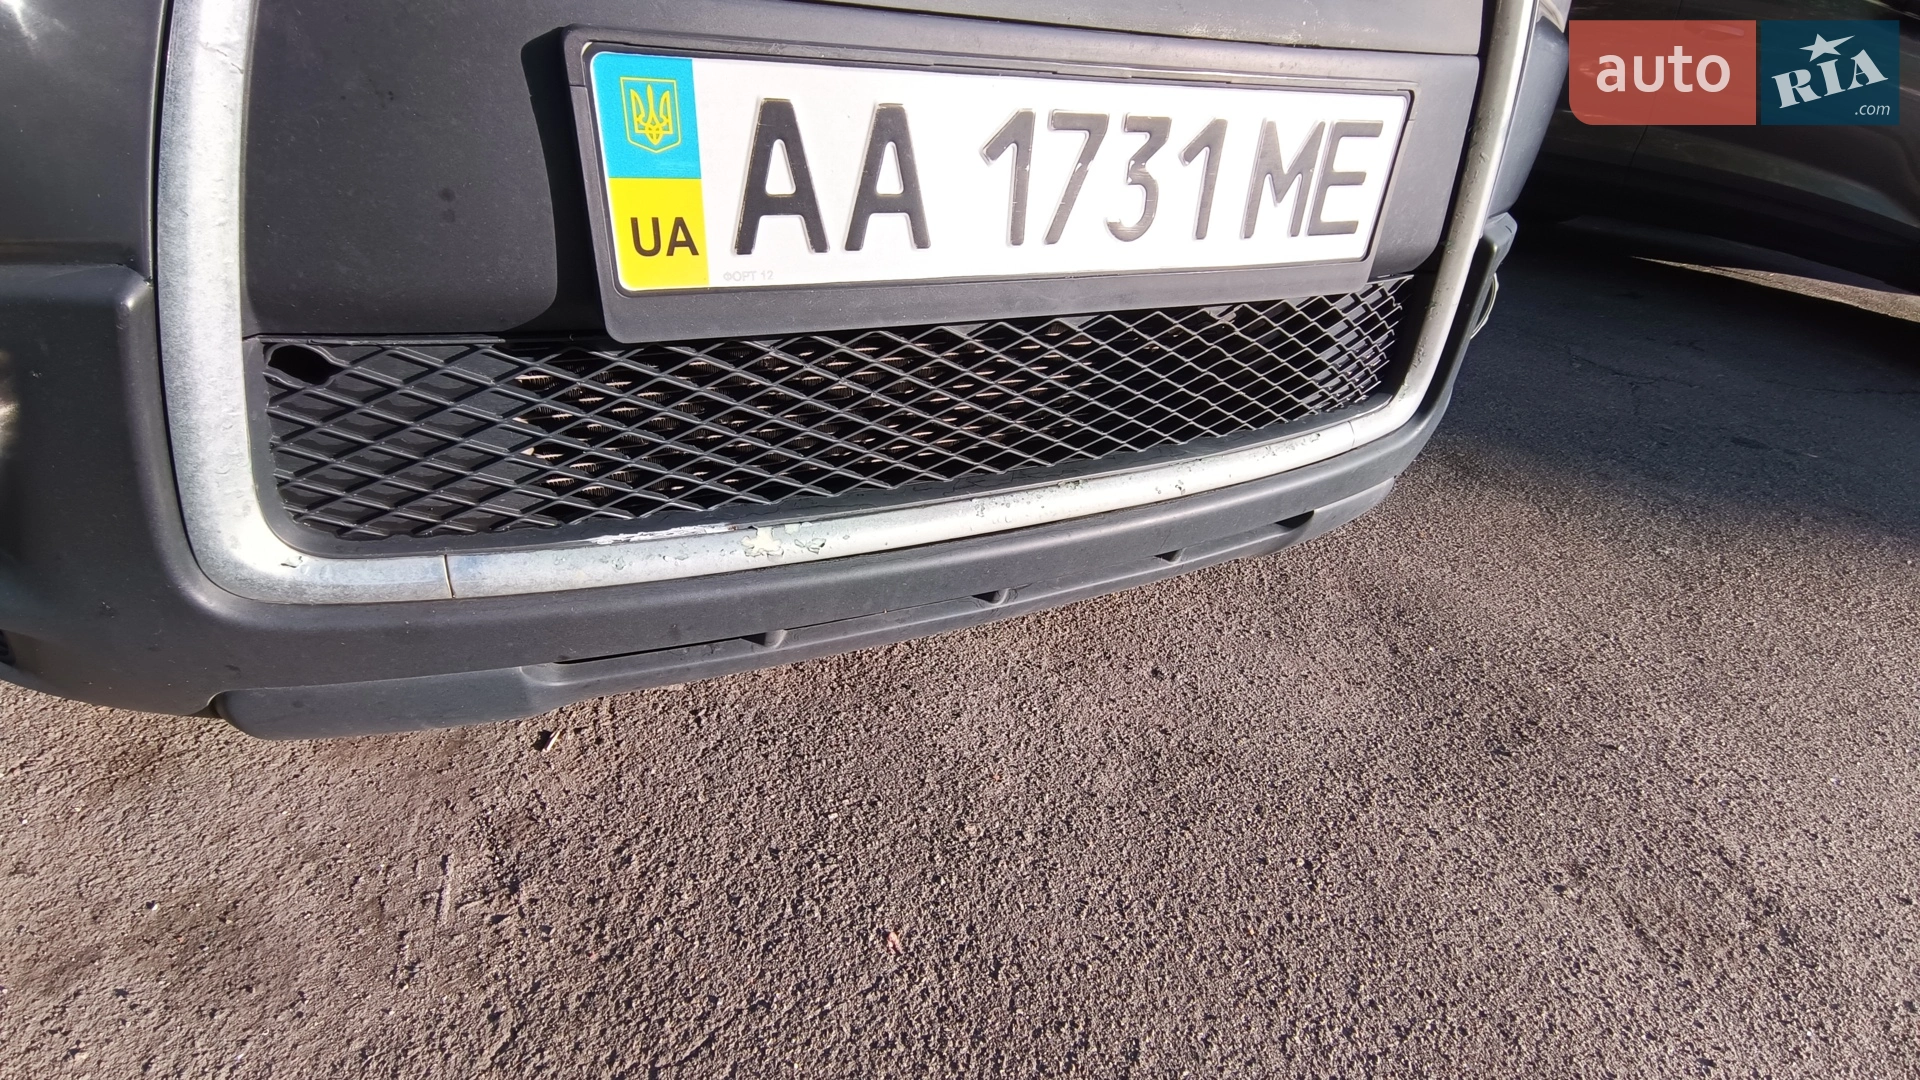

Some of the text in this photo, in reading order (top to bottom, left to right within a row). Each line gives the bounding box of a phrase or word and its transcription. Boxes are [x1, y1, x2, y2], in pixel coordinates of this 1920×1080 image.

[734, 97, 1384, 255] AA 1731 ME
[630, 216, 700, 257] UA
[760, 270, 774, 281] 12
